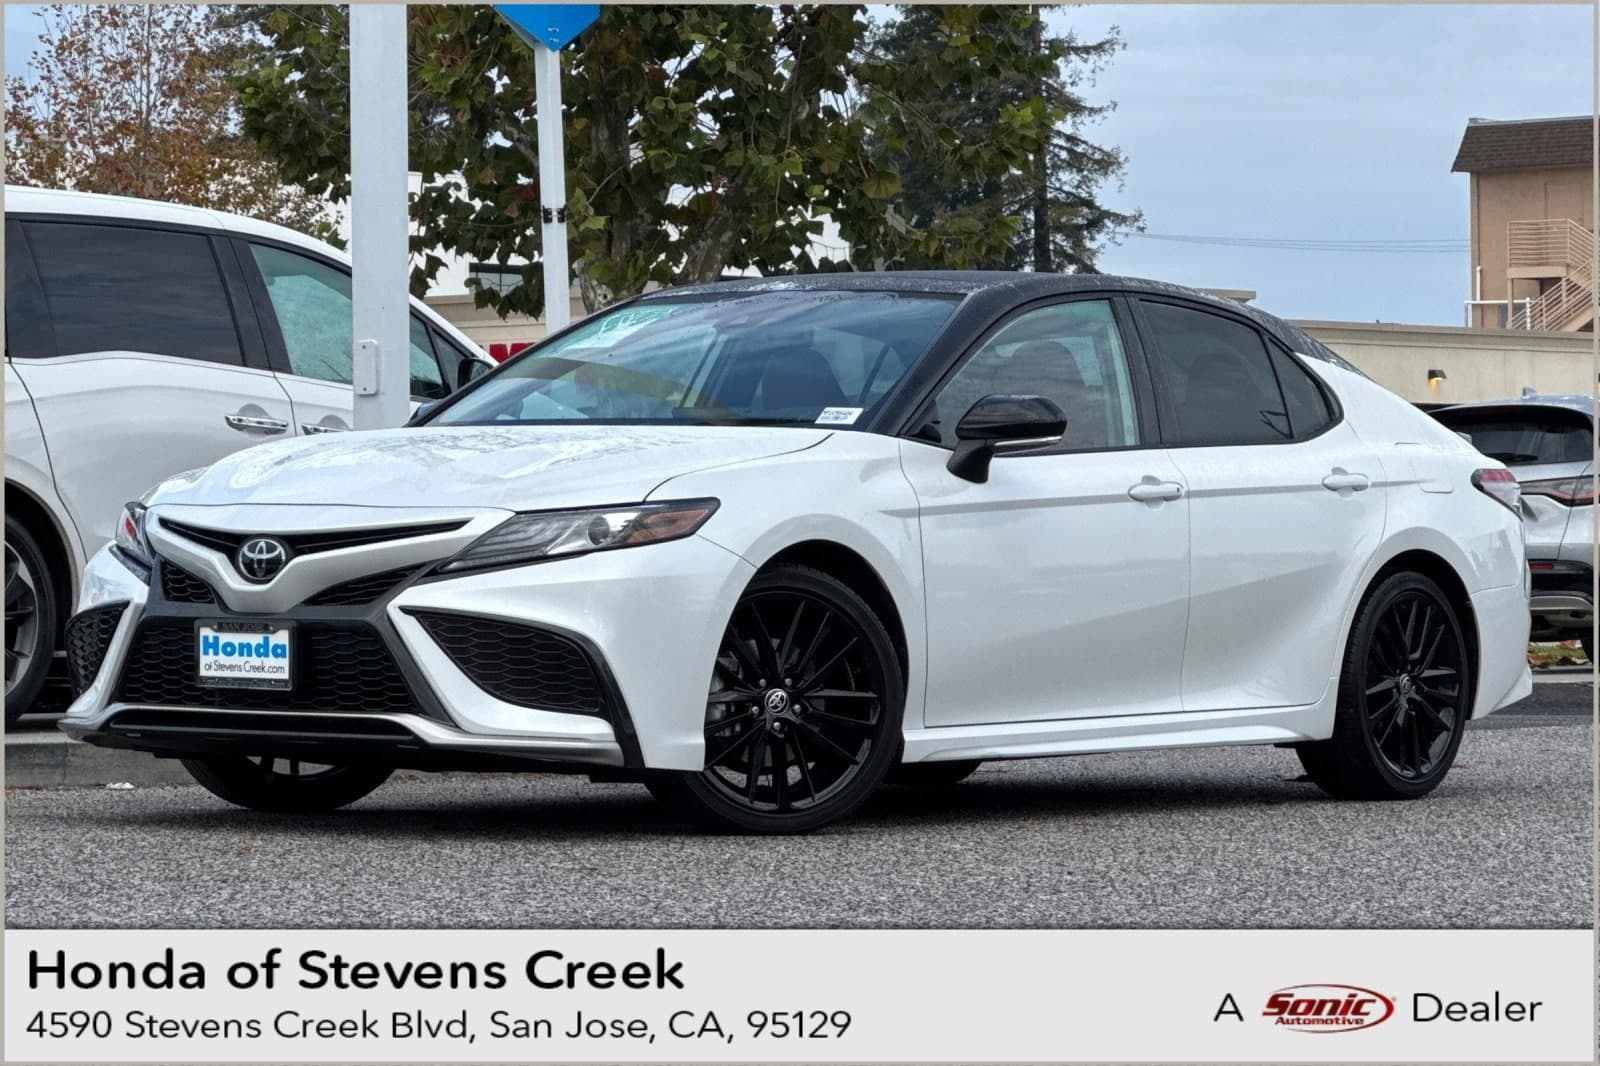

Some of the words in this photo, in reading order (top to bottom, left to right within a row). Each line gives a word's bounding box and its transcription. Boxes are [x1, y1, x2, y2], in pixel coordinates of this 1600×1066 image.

[202, 635, 287, 659] Honda
[204, 661, 213, 672] of
[213, 660, 242, 673] Stevens
[243, 660, 285, 674] Creek.com
